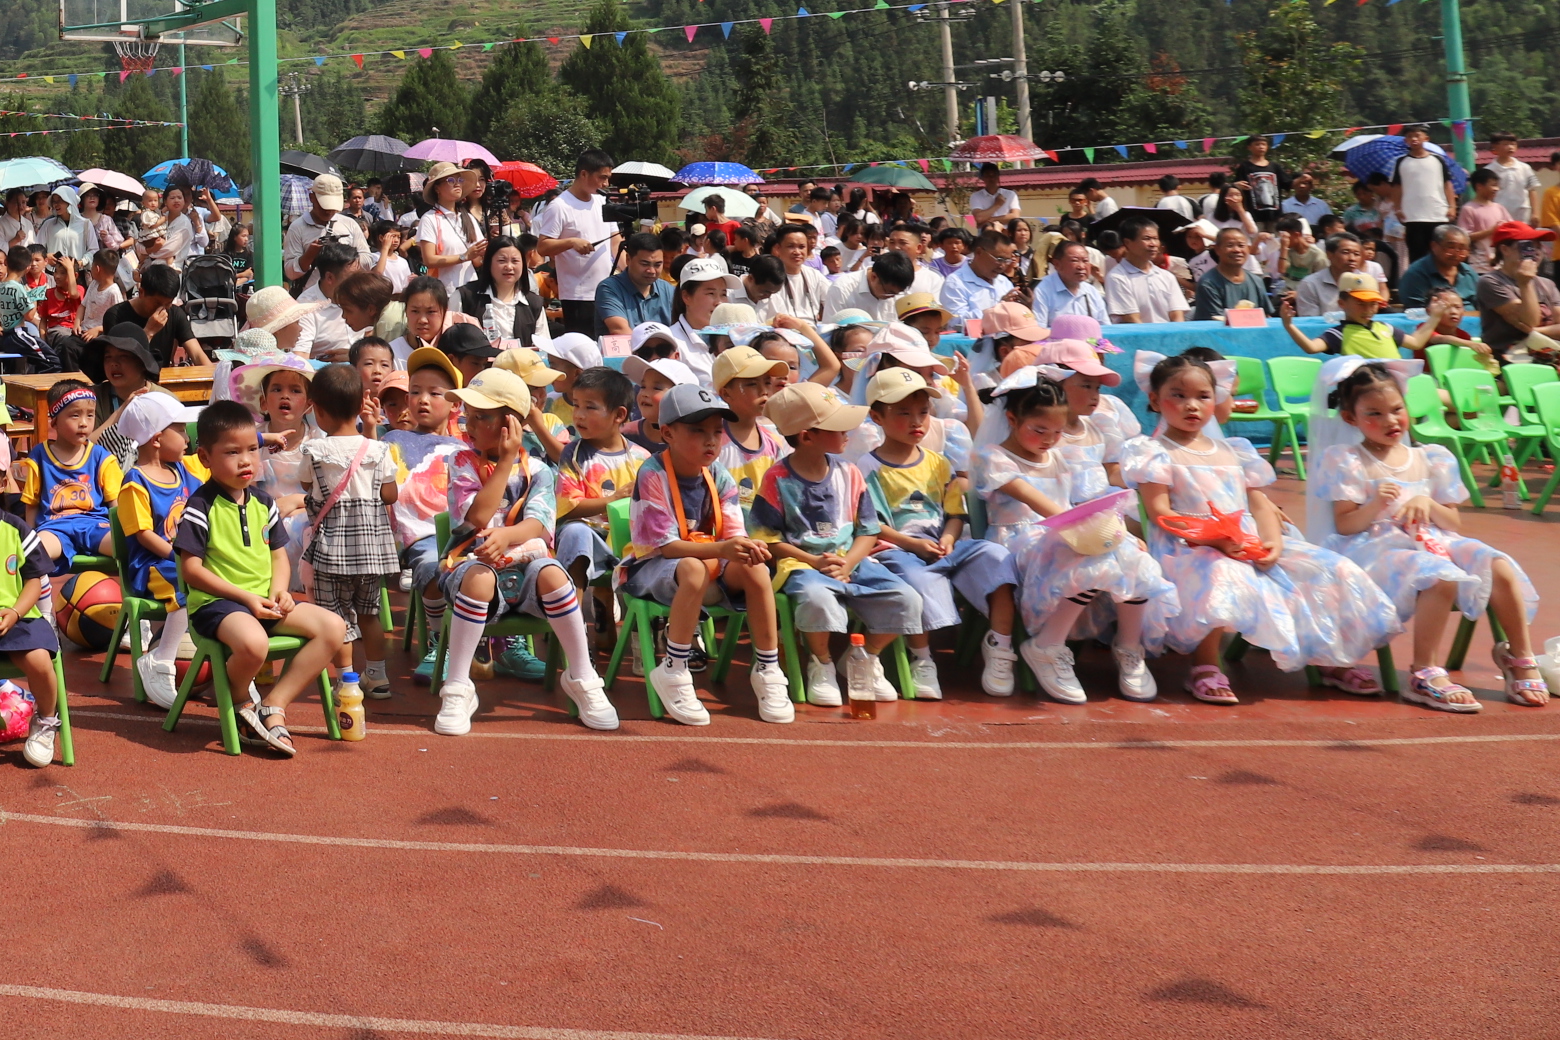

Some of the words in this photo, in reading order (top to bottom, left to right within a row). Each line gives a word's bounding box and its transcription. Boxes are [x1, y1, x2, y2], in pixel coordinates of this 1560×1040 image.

[900, 371, 913, 382] B
[52, 390, 93, 414] GIVEMCHY
[698, 390, 712, 403] C
[71, 489, 86, 501] 30
